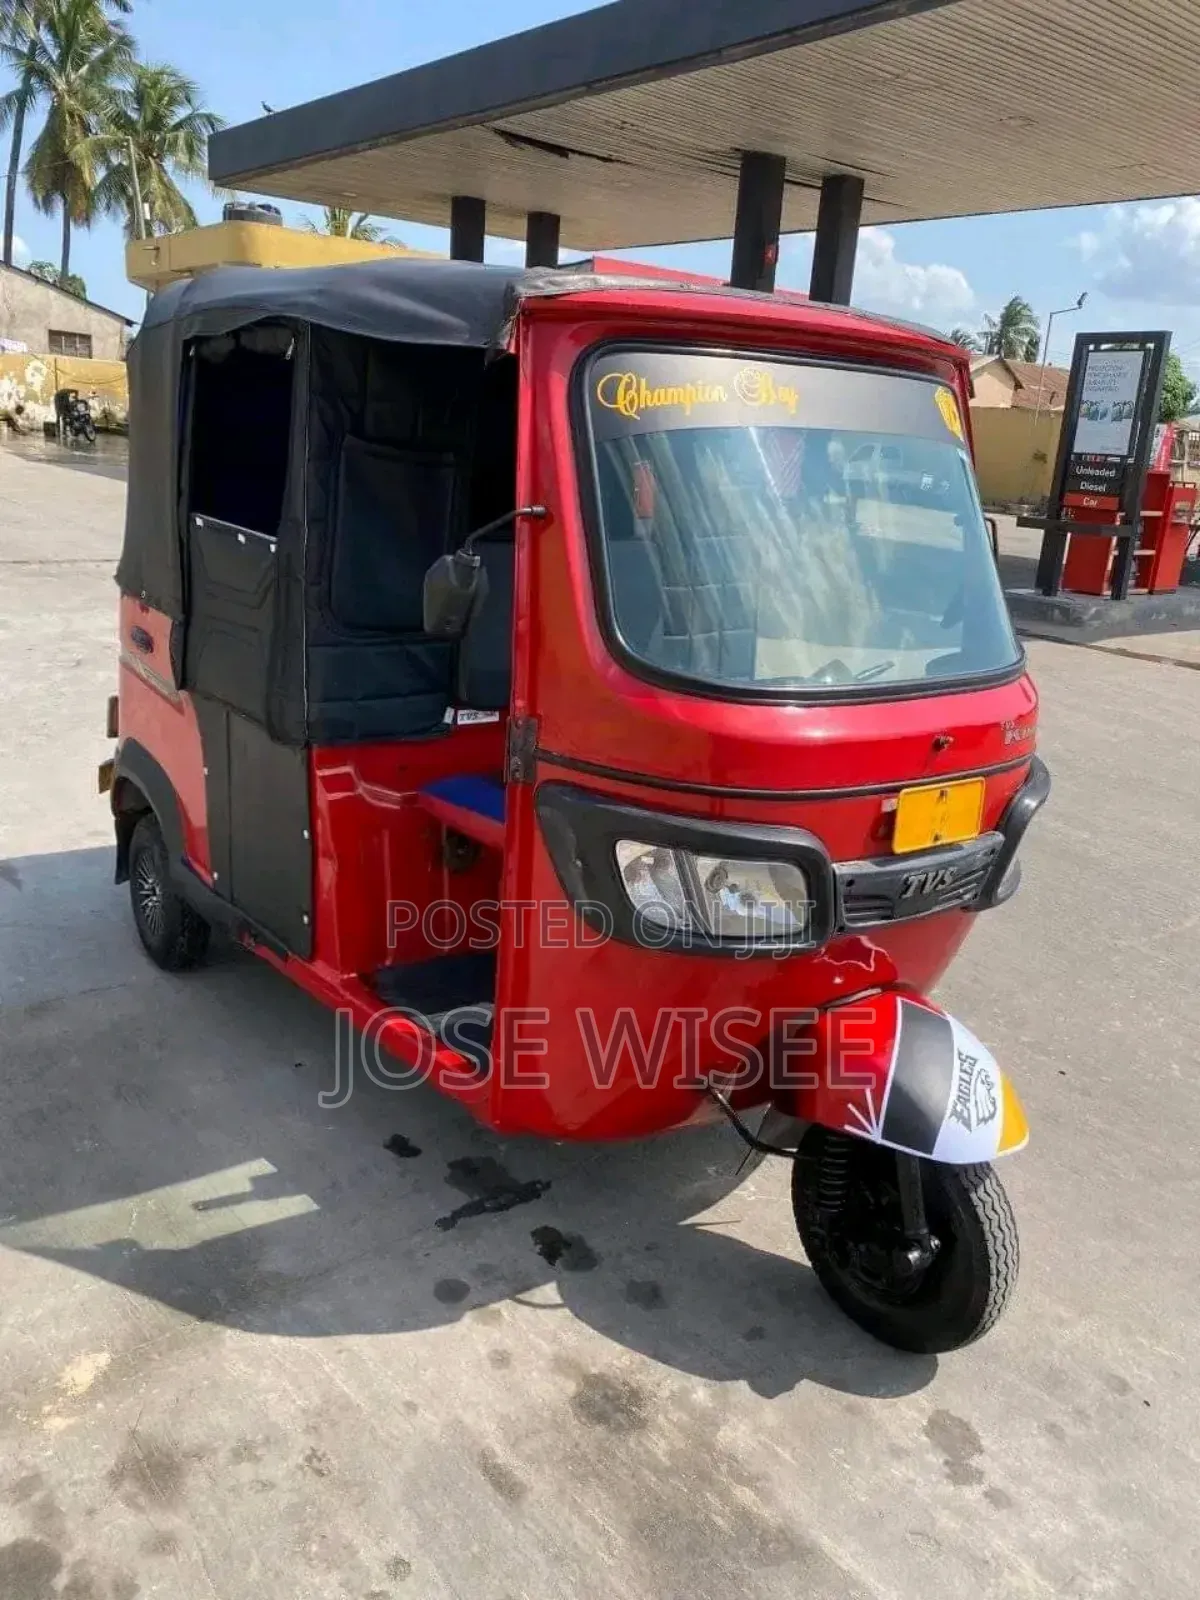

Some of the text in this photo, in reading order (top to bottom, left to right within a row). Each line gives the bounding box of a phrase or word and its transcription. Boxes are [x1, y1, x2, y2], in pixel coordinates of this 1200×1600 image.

[597, 372, 728, 420] Champion
[1075, 465, 1116, 477] Unleaded
[1080, 481, 1107, 492] Diesel
[1083, 497, 1098, 506] Car
[899, 866, 957, 899] TVS
[948, 1047, 979, 1133] EAGLES
